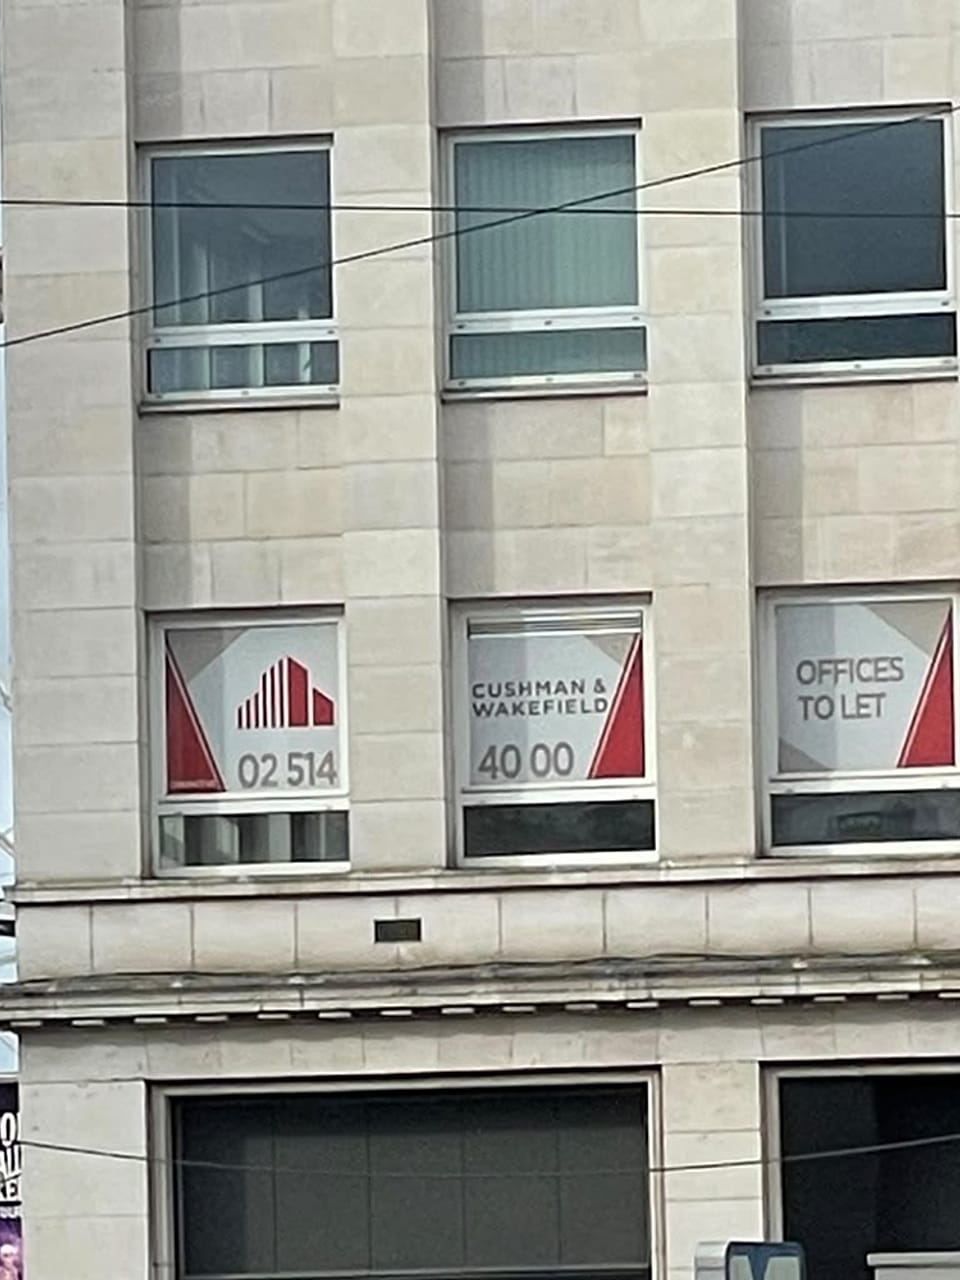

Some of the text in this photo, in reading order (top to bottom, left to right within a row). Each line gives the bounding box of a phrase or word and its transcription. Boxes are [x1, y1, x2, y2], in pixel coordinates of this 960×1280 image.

[796, 656, 905, 685] OFFICES
[471, 677, 607, 699] CUSHMAN &
[472, 697, 609, 717] WAKEFIELD
[798, 692, 886, 721] TO LET
[238, 750, 338, 788] 02 514
[478, 741, 574, 780] 40 00
